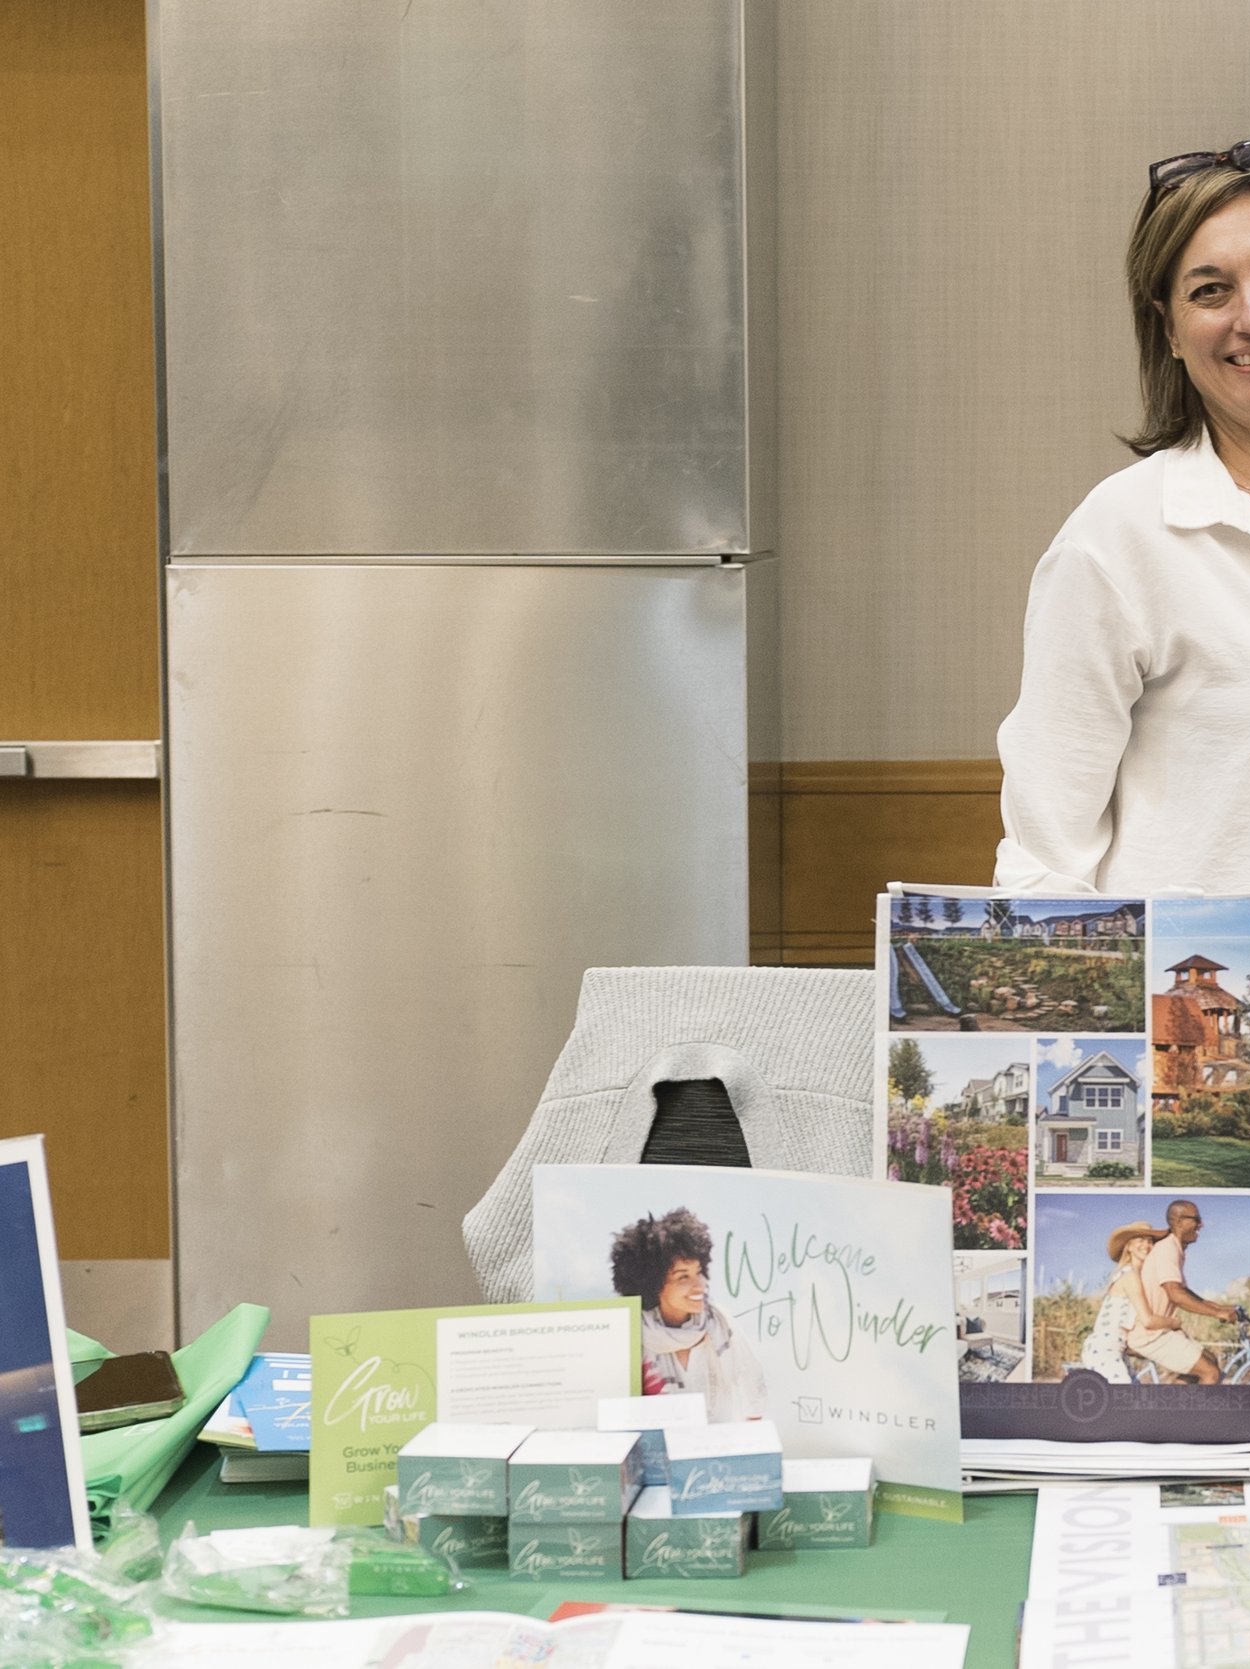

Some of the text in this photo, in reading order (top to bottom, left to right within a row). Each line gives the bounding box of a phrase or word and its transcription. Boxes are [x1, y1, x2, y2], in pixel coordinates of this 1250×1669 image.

[725, 1213, 876, 1298] Welcome
[458, 1323, 611, 1340] WINDLER BROKER PROGRAM
[734, 1276, 947, 1371] To Windler
[324, 1356, 419, 1432] Grow
[368, 1410, 427, 1425] YOUR LIFE
[828, 1406, 937, 1431] WINDLER
[343, 1446, 381, 1458] Grow
[407, 1472, 447, 1506] Grow
[475, 1489, 496, 1498] LIFE
[514, 1479, 556, 1515] Grow
[585, 1496, 605, 1506] LIFE
[882, 1491, 947, 1508] SUSTAINABLE
[767, 1508, 809, 1544] Grow
[810, 1522, 834, 1533] YOUR
[836, 1521, 856, 1531] LIFE
[514, 1539, 556, 1572] Grow
[585, 1555, 605, 1565] LIFE
[1053, 1596, 1131, 1669] THE
